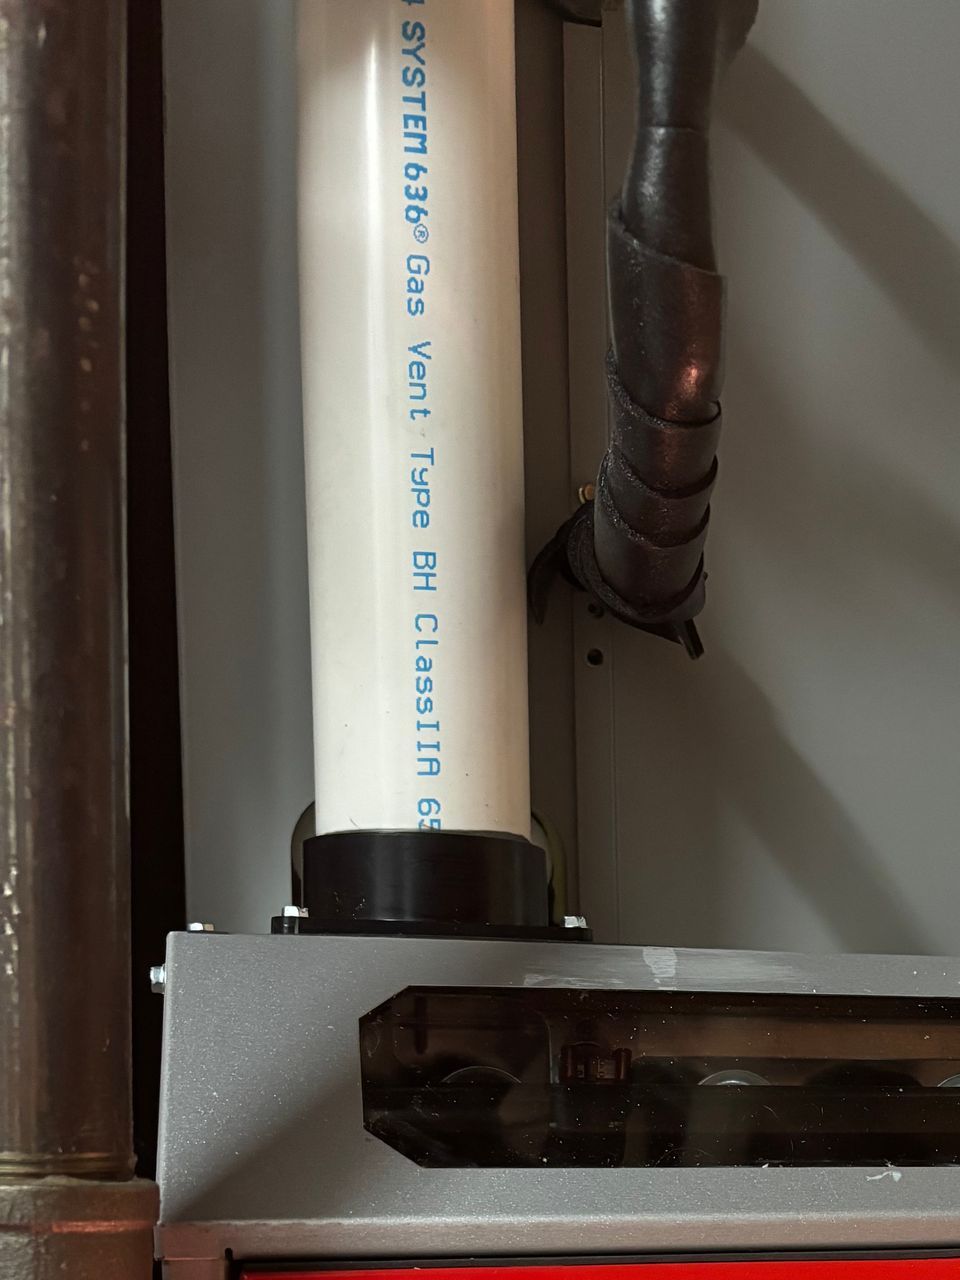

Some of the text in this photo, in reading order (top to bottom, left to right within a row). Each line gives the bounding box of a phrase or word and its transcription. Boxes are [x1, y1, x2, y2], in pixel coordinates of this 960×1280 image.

[401, 19, 429, 155] SYSTEM
[406, 253, 431, 317] Gas
[408, 341, 432, 421] Vent
[411, 447, 435, 529] Type
[413, 551, 437, 591] BH
